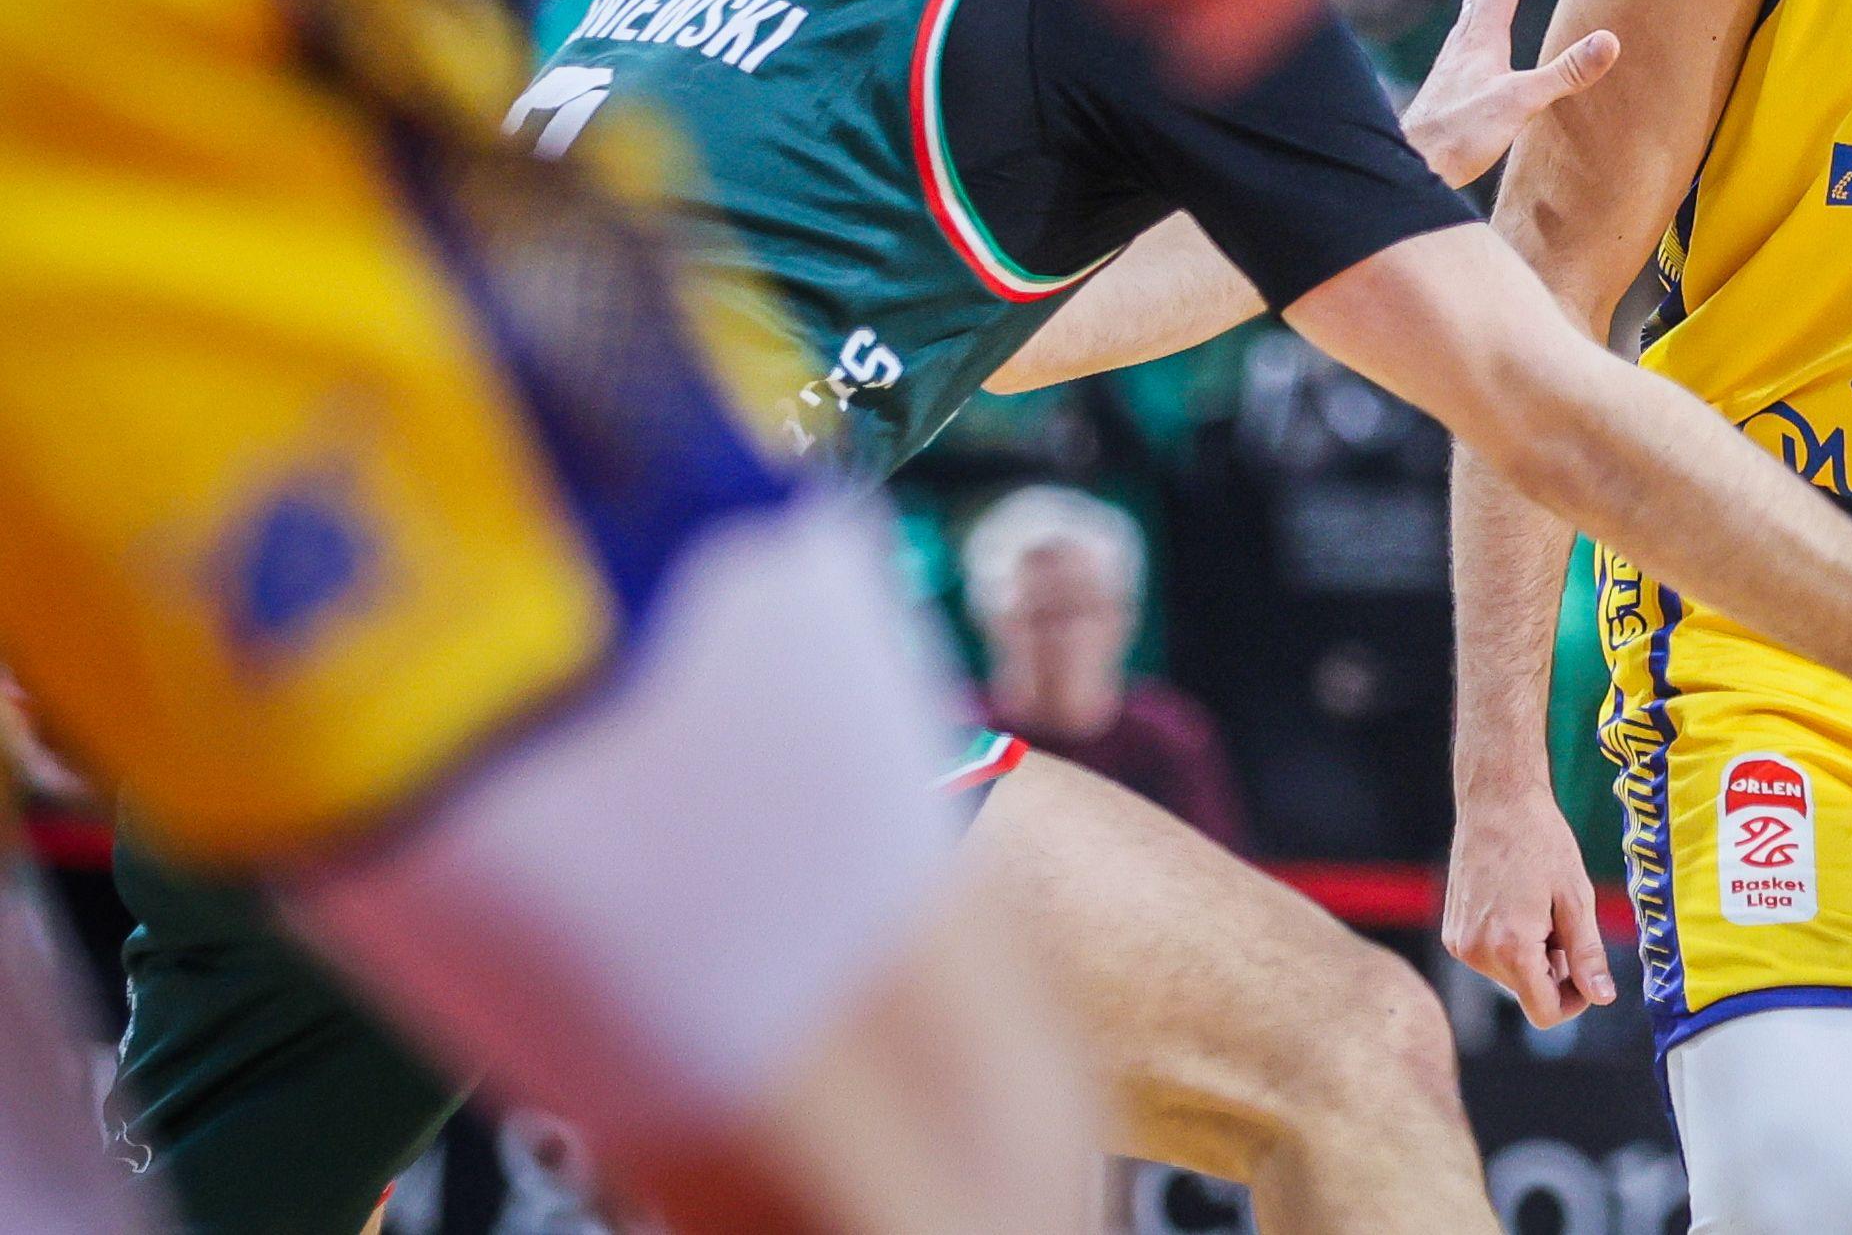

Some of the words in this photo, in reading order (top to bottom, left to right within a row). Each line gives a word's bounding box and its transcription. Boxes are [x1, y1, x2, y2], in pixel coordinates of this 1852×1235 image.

[1730, 778, 1803, 798] ORLEN
[1731, 877, 1807, 894] Basket
[1746, 893, 1793, 910] Liga
